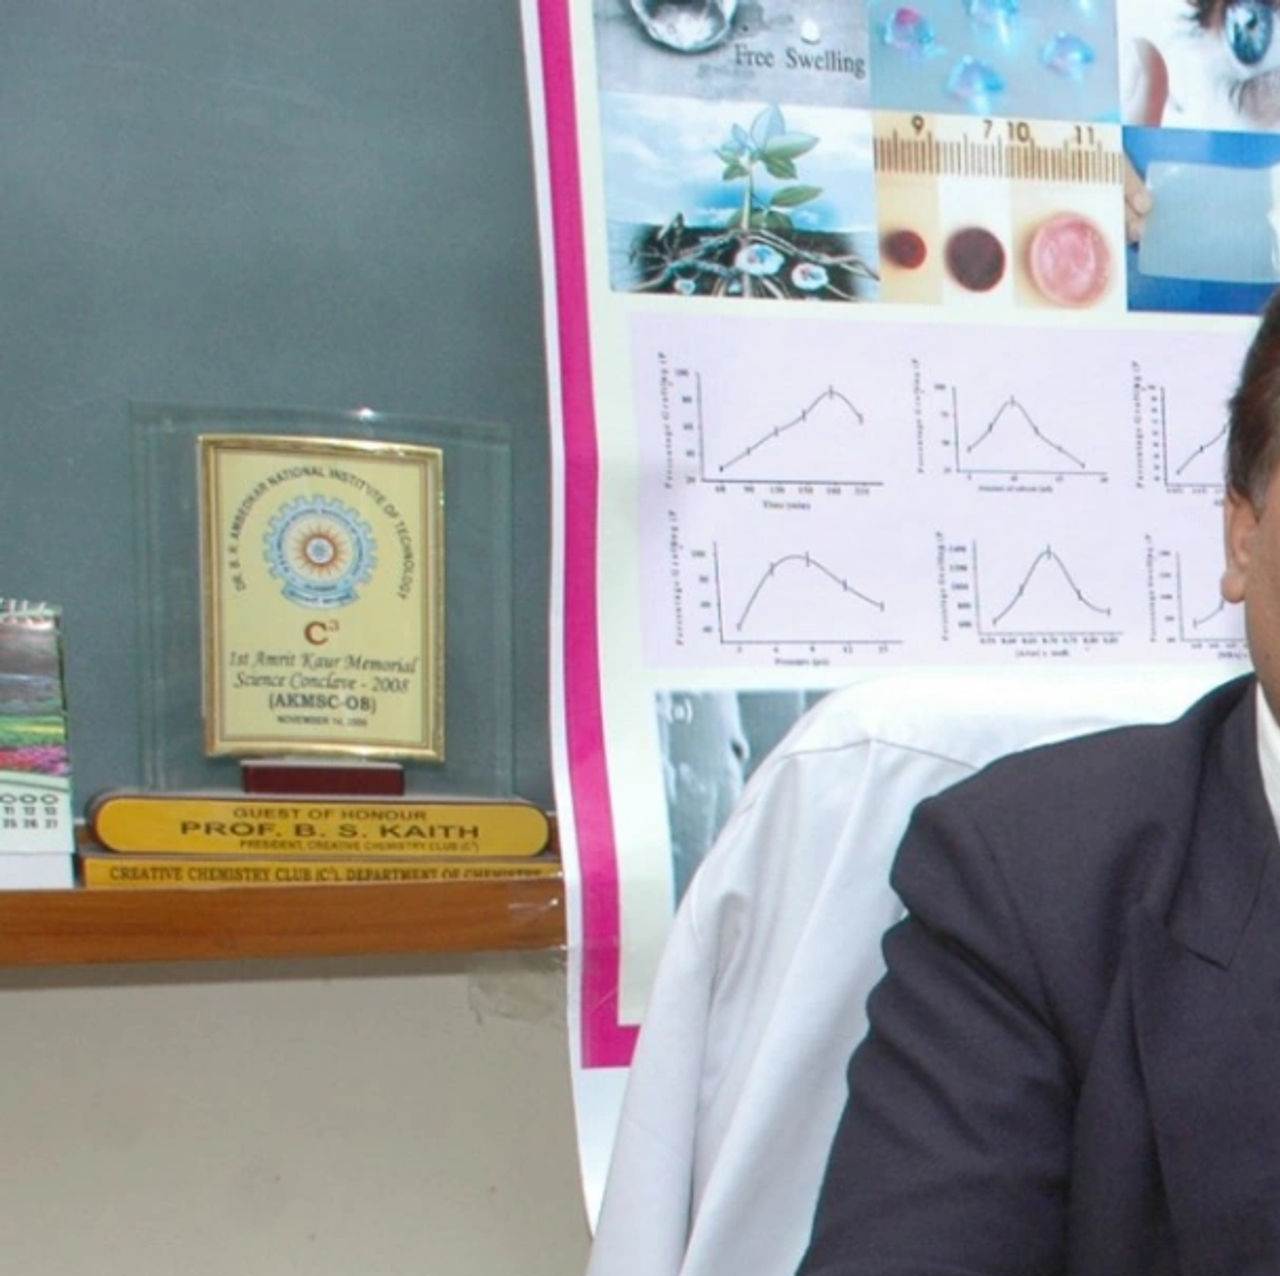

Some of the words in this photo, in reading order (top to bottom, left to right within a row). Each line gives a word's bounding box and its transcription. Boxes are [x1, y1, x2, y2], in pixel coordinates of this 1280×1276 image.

[734, 43, 775, 68] Free
[785, 45, 866, 80] Swelling
[911, 114, 925, 136] 9
[983, 119, 993, 140] 7
[1007, 121, 1030, 144] 10
[1074, 125, 1095, 147] 11
[252, 650, 297, 668] Amrit
[300, 651, 341, 671] Kaur
[343, 653, 420, 675] Memorial
[233, 670, 286, 690] Science
[289, 672, 357, 691] Conclave
[232, 807, 301, 820] GUEST
[307, 808, 336, 821] OF
[341, 808, 428, 821] HONOUR
[180, 820, 282, 838] PROF.
[294, 822, 327, 838] B.
[338, 823, 368, 839] S.
[379, 825, 480, 839] KAITH
[109, 866, 184, 882] CREATIVE
[187, 866, 271, 882] CHEMISTRY
[275, 867, 312, 882] CLUB
